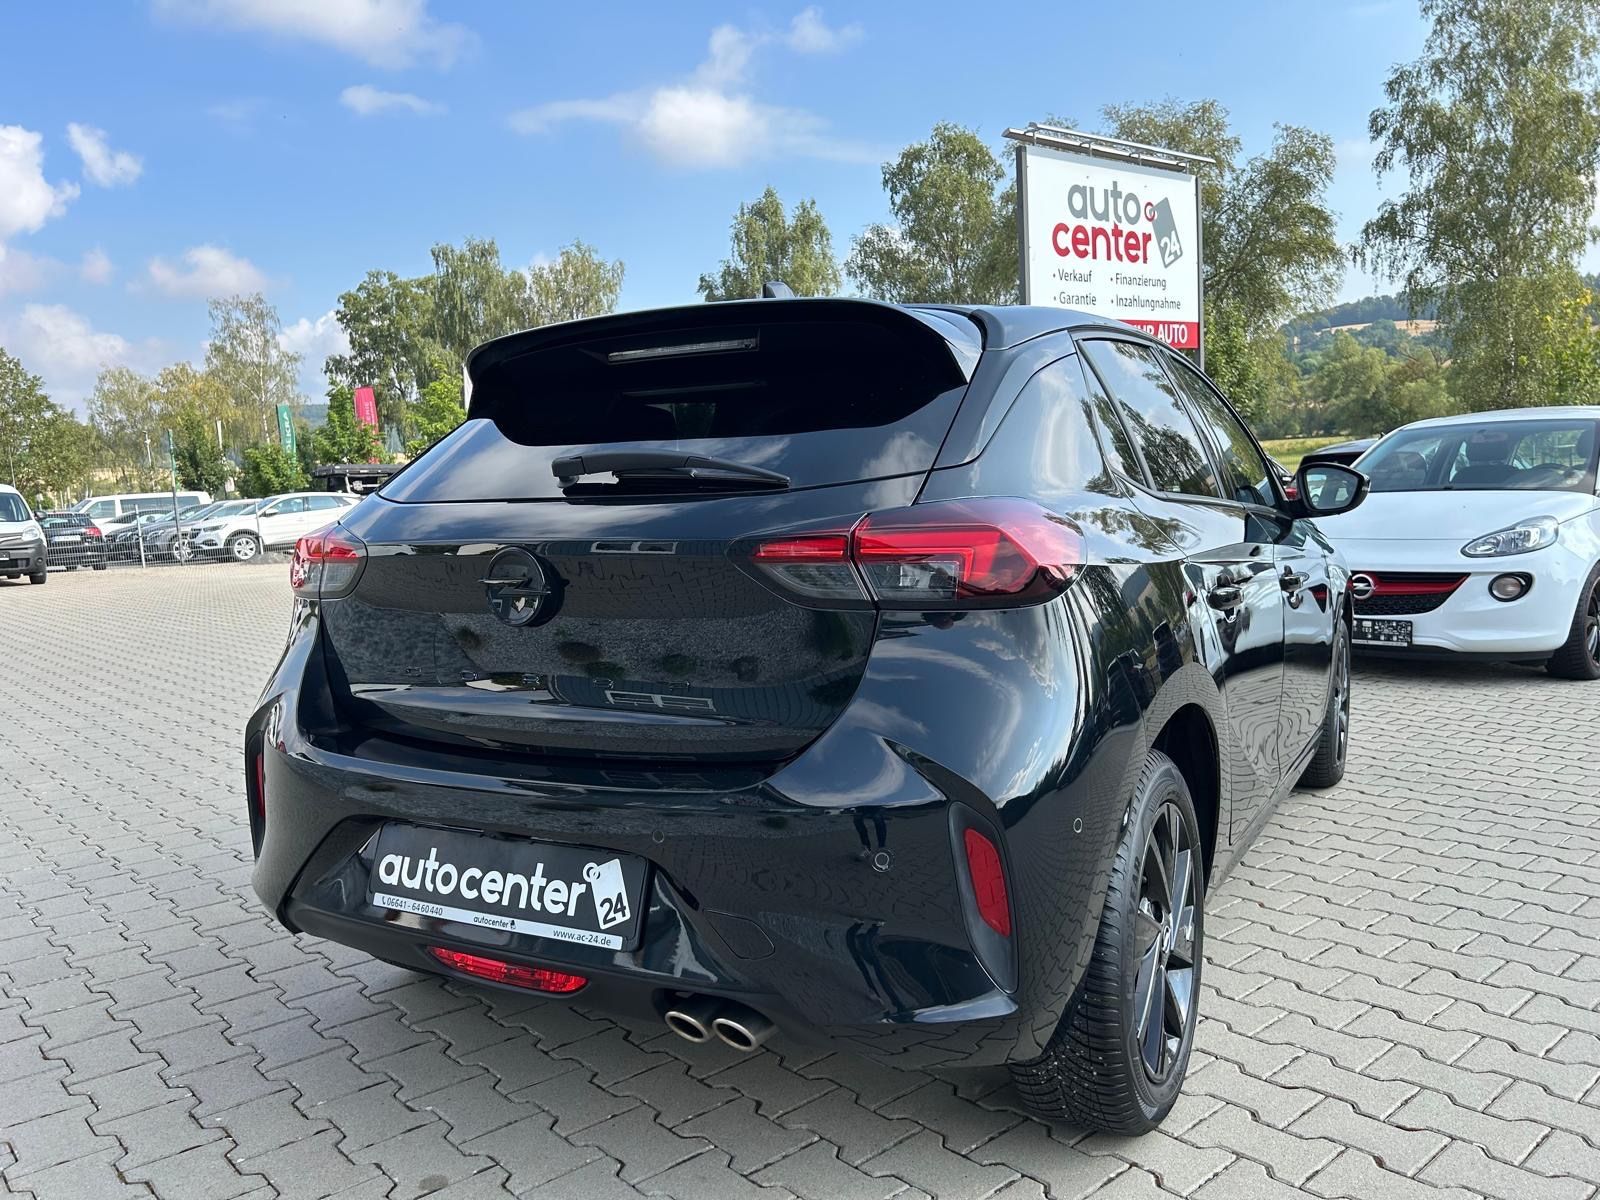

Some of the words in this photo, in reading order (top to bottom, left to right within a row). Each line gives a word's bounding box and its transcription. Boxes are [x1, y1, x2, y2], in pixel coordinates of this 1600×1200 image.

[1067, 180, 1141, 225] auto
[1052, 221, 1152, 264] center
[1160, 230, 1181, 262] 24
[1058, 268, 1093, 283] Verkauf
[1115, 272, 1167, 291] Finanzierung
[1059, 291, 1097, 306] Garantie
[1115, 294, 1181, 311] Inzahlungnahme
[1158, 323, 1188, 344] AUTO
[378, 847, 587, 917] autocenter
[599, 891, 627, 926] 24
[473, 915, 509, 929] autocenter
[552, 928, 612, 947] www.ac-24.de
